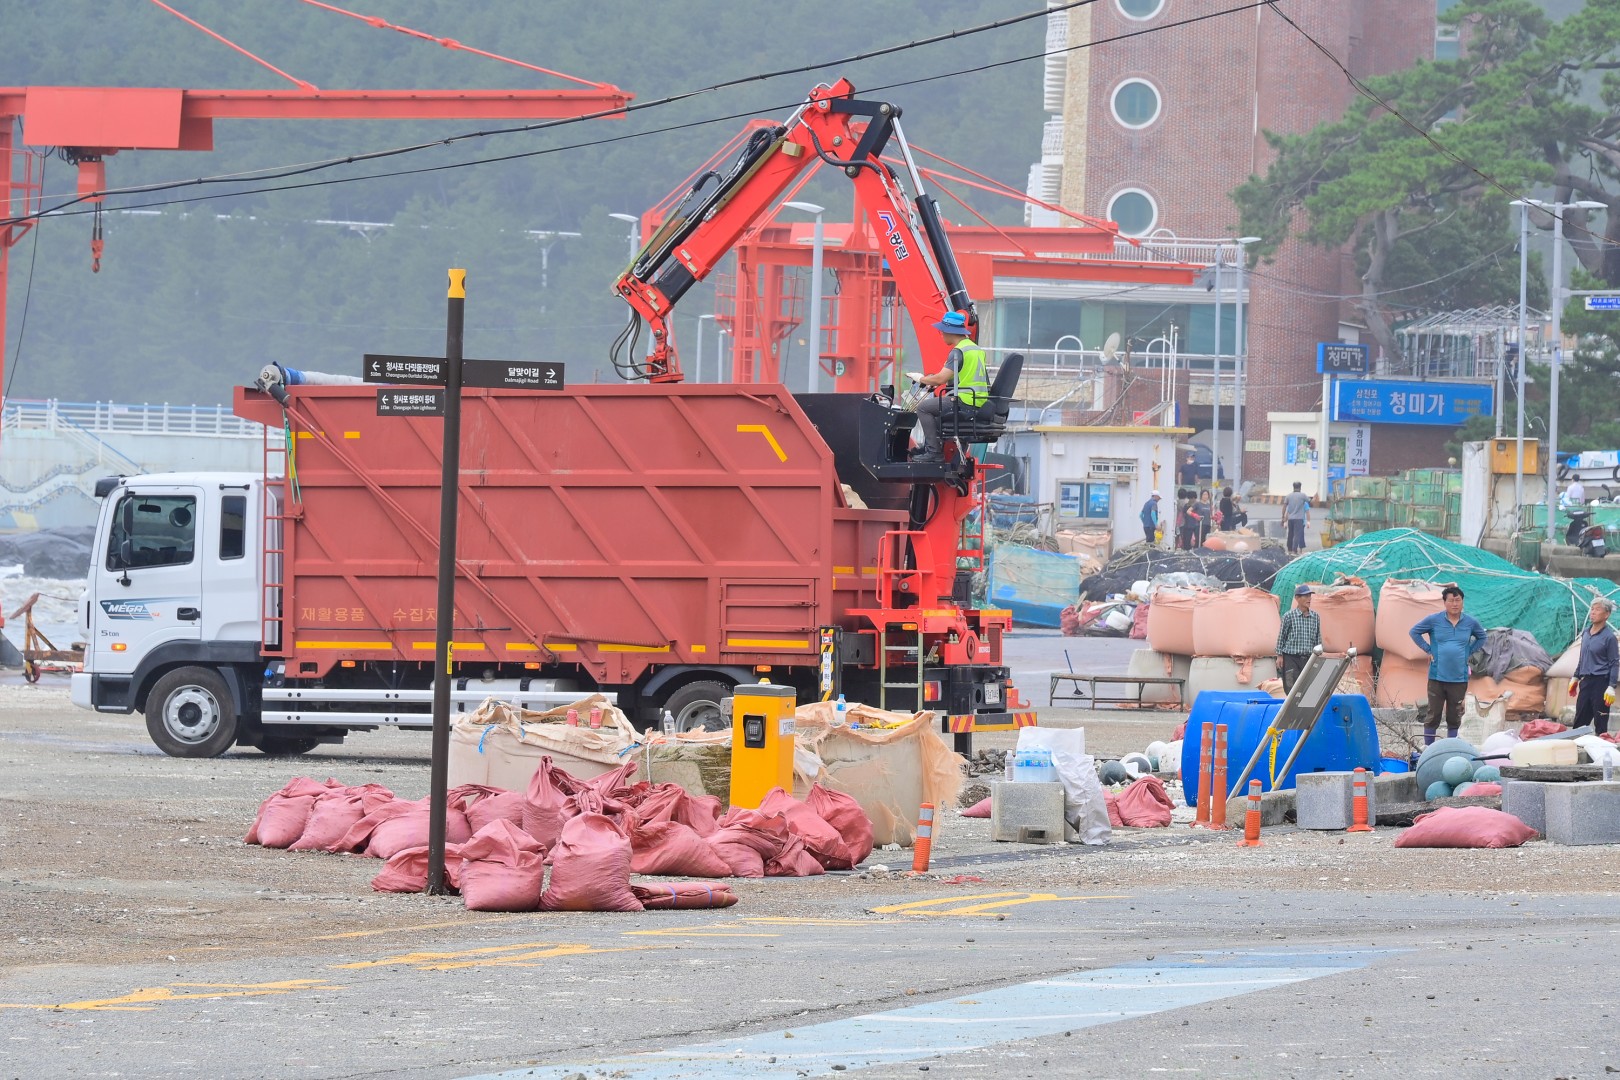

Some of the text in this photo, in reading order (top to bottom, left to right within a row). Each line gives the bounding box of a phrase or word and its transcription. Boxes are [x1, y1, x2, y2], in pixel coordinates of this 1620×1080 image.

[1328, 350, 1364, 367] 청미가
[385, 361, 440, 373] 청사포 다릿돌전망대
[508, 367, 539, 378] 달맞이길
[393, 395, 436, 404] 청사포 쌍둥이 등대
[1389, 391, 1445, 416] 청미가
[1355, 429, 1364, 457] 청미가
[1350, 458, 1368, 466] 주차장
[107, 604, 144, 613] MEGA
[300, 606, 366, 622] 재활용품
